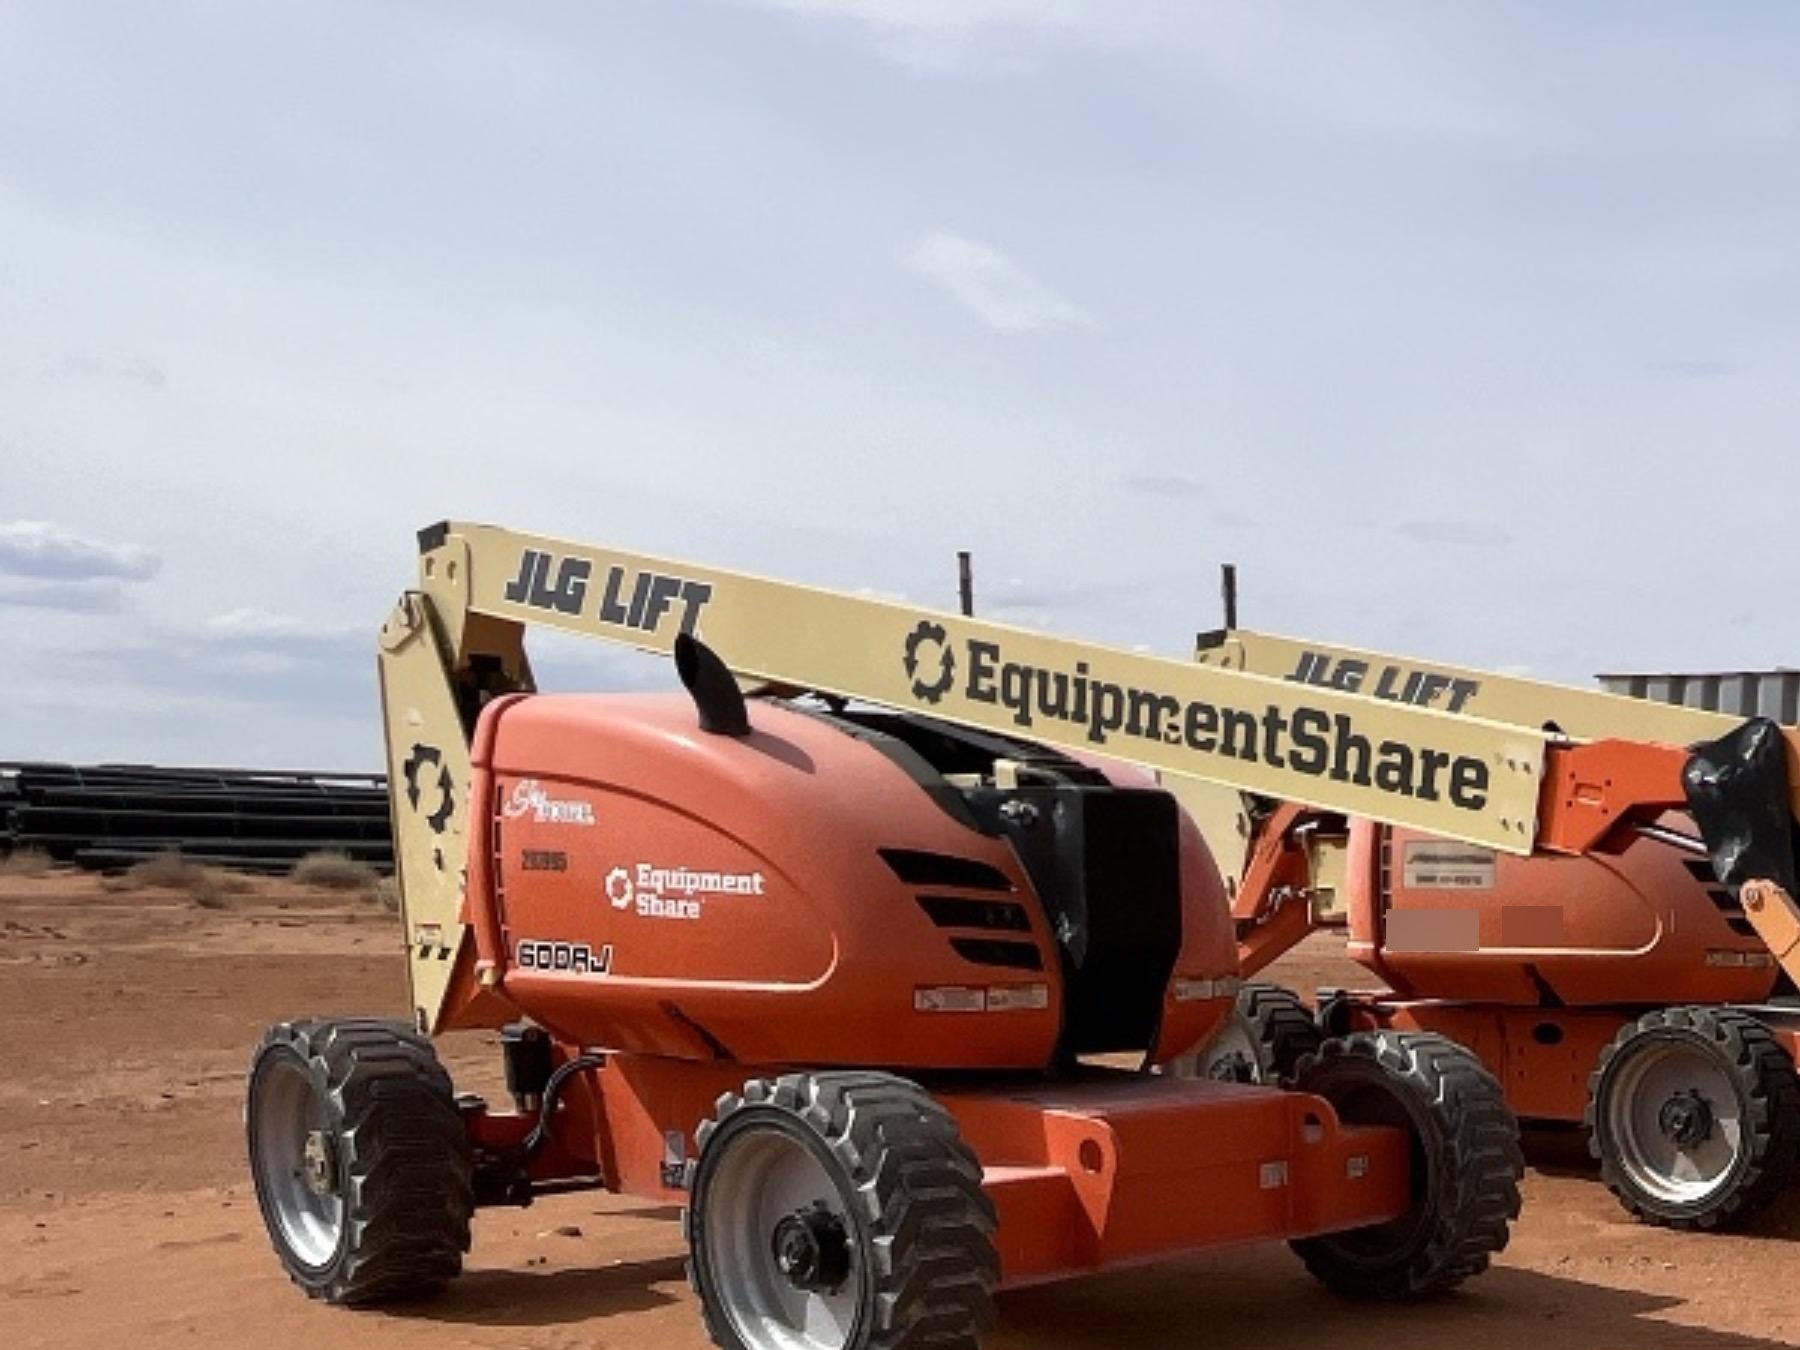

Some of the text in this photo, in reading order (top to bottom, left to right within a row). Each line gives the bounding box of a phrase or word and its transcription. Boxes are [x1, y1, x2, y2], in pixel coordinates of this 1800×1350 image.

[504, 549, 712, 636] JLG LIFT
[1284, 650, 1482, 715] JLG LIFT
[965, 637, 1489, 812] EquipmentShare
[636, 863, 766, 895] Equipment
[636, 892, 701, 919] Share
[517, 939, 613, 976] 600AJ
